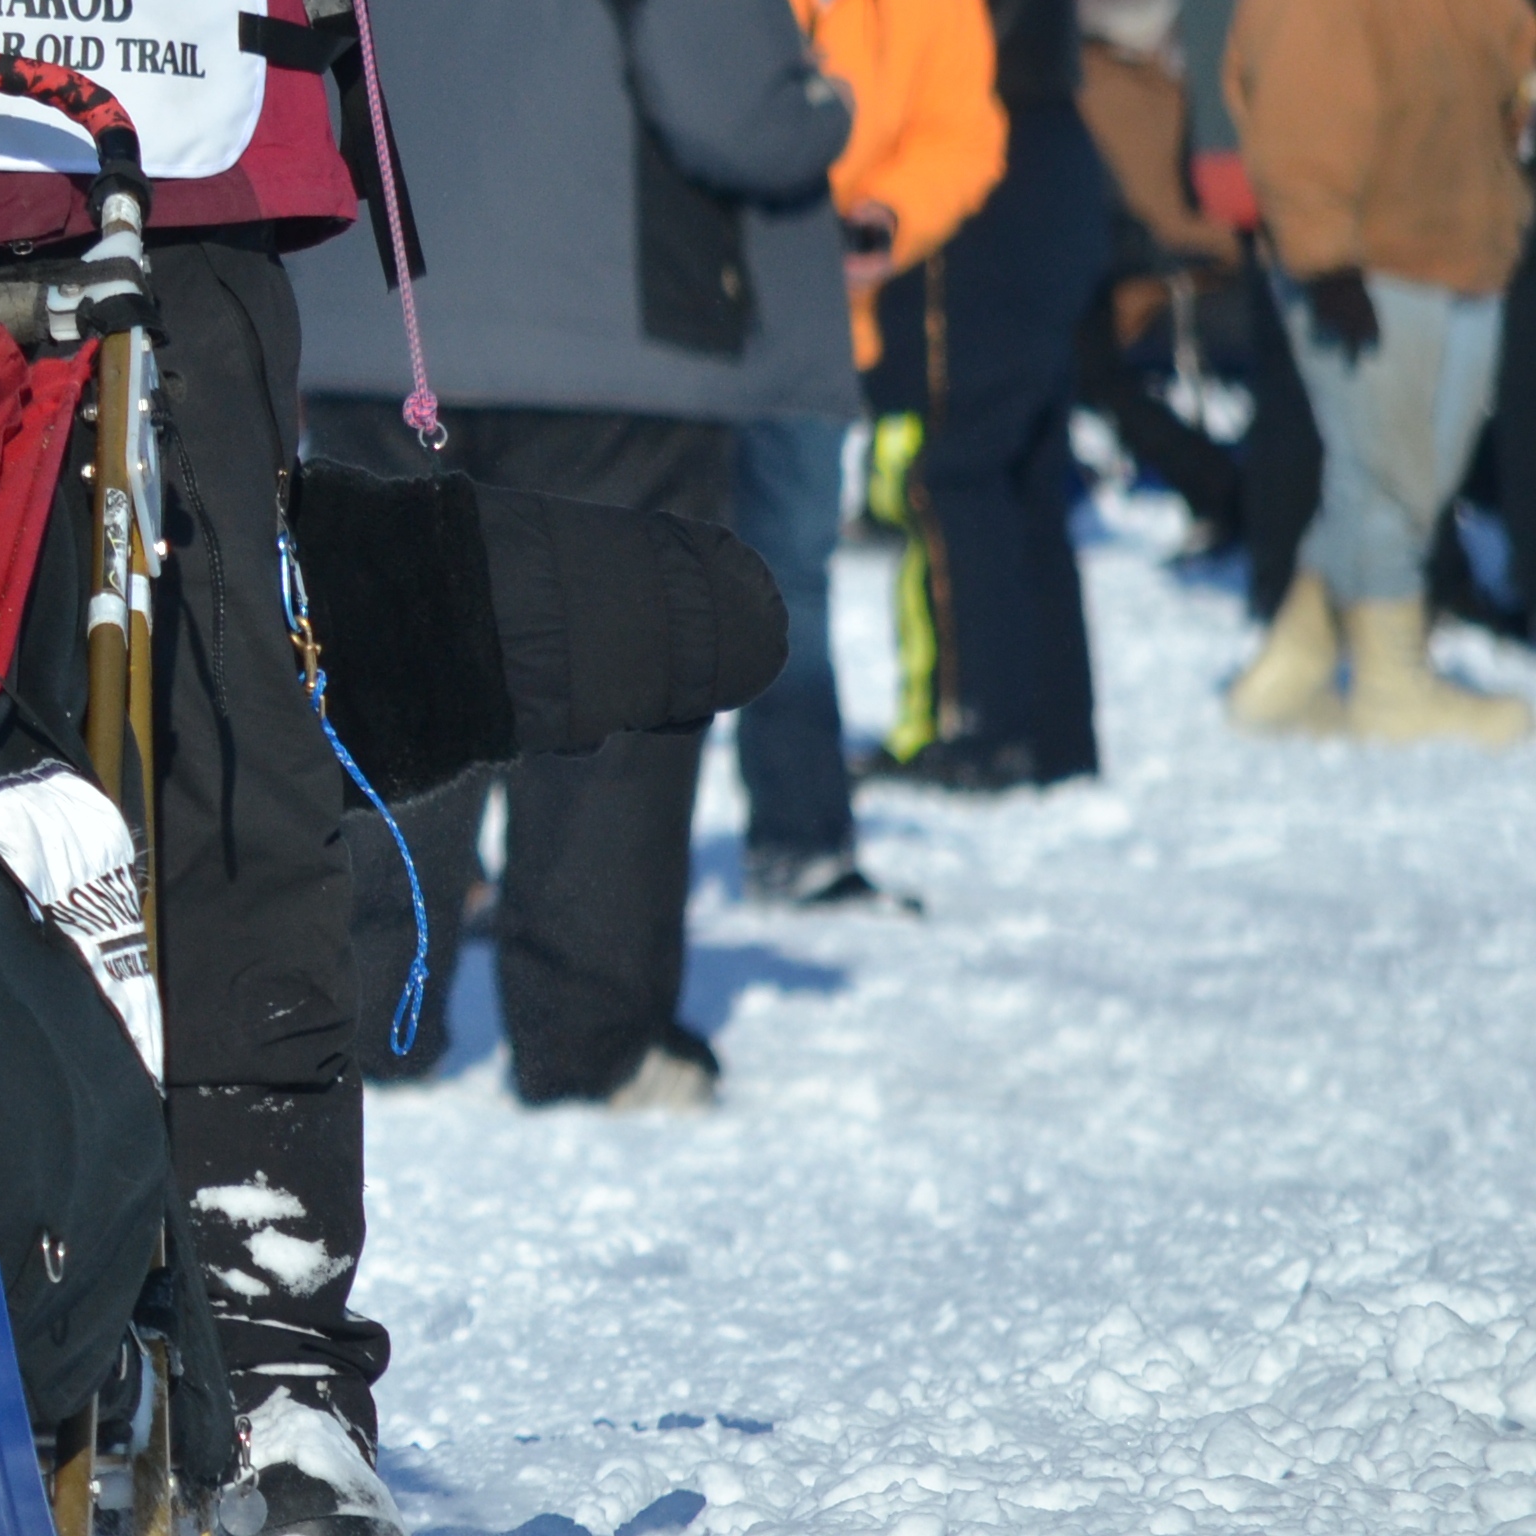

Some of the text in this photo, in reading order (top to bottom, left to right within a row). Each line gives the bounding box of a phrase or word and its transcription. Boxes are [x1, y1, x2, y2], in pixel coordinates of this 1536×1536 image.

[35, 34, 106, 71] OLD
[115, 38, 207, 78] TRAIL
[44, 864, 141, 936] PIONEE
